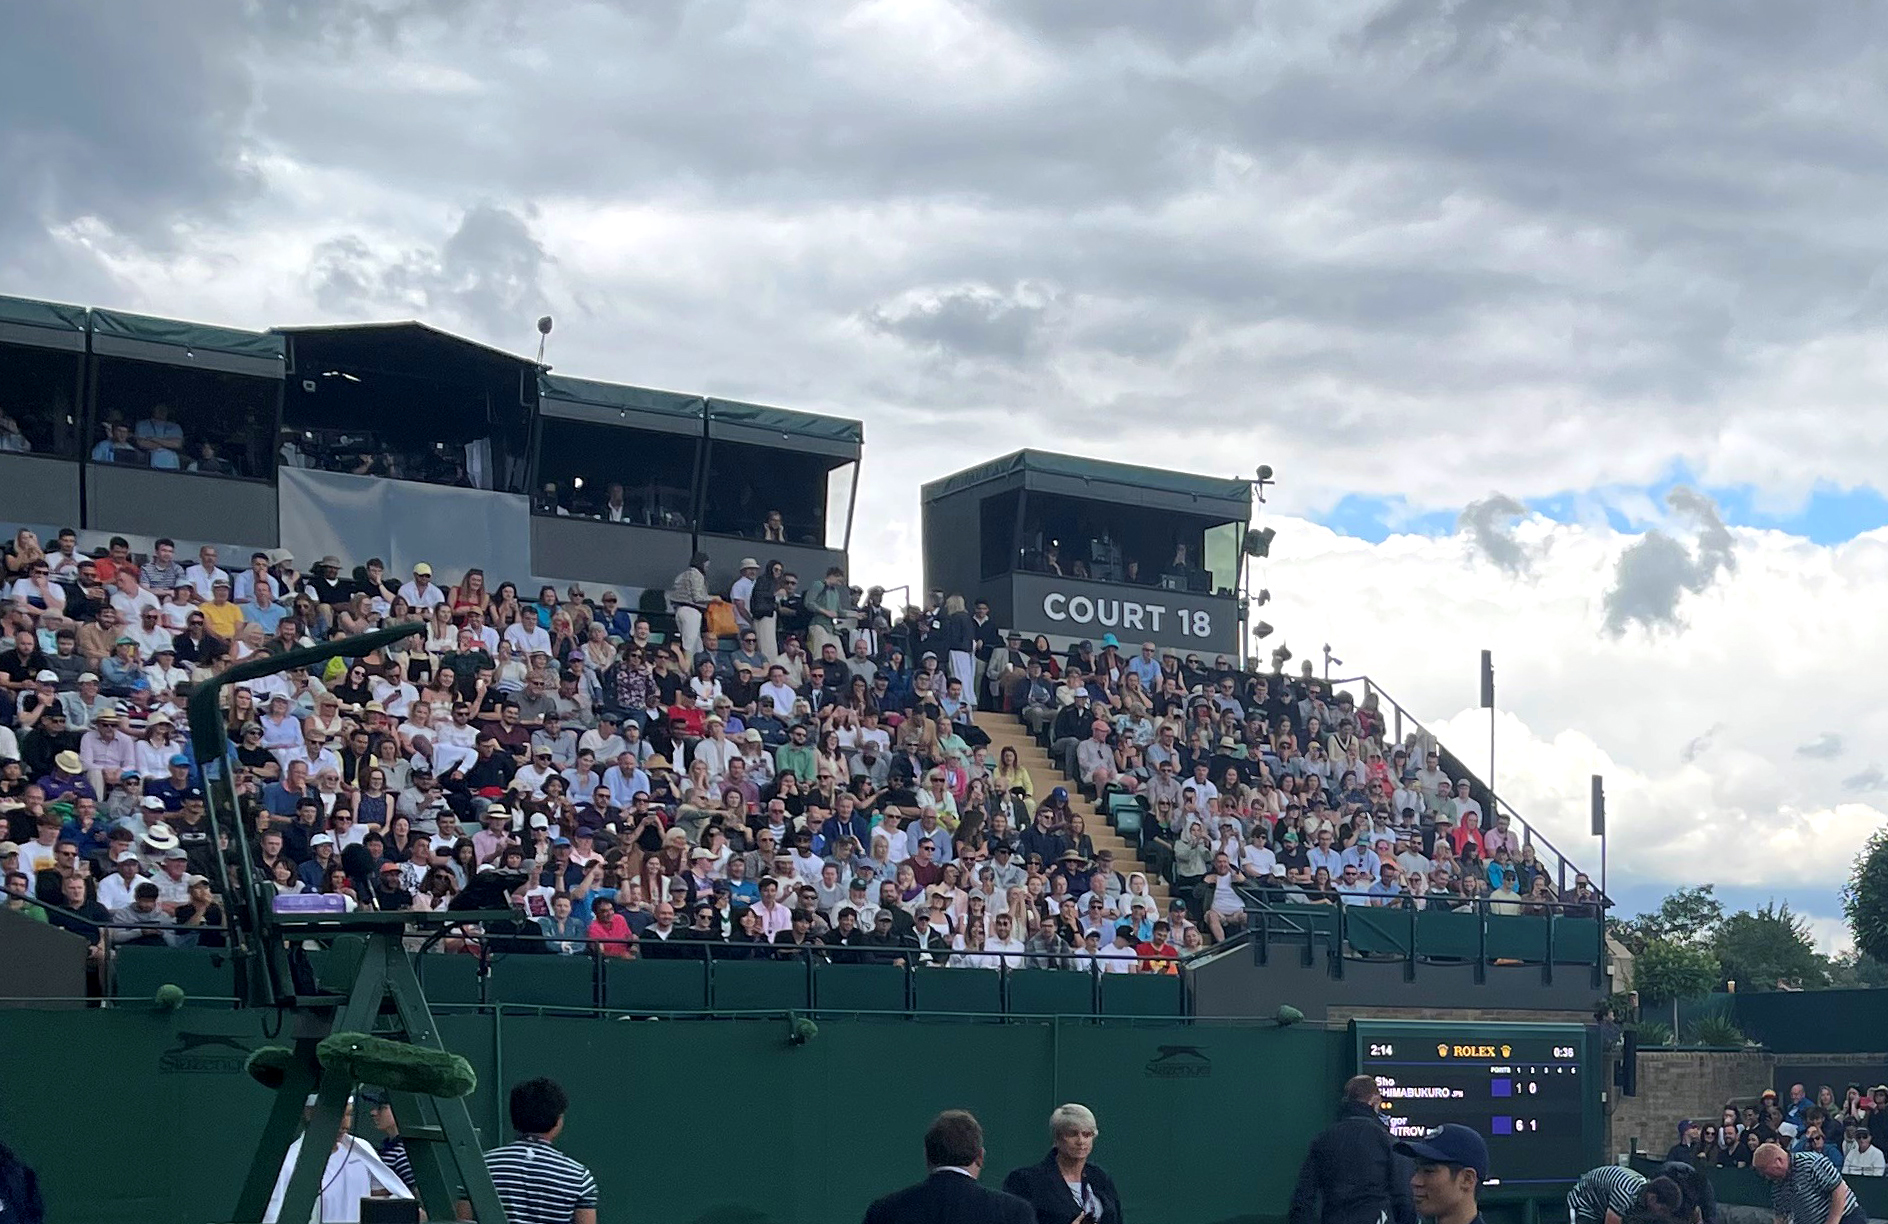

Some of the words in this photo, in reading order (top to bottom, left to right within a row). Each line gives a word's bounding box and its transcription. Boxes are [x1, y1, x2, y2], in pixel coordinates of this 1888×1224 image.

[1043, 592, 1166, 632] COURT
[1177, 608, 1212, 638] 18
[1370, 1044, 1393, 1056] 2:14
[1453, 1045, 1496, 1057] ROLEX
[1530, 1066, 1536, 1074] 2
[1374, 1076, 1395, 1087] Sho
[1515, 1082, 1522, 1094] 1
[1528, 1082, 1537, 1094] 0
[1515, 1119, 1524, 1131] 6
[1529, 1119, 1537, 1131] 1
